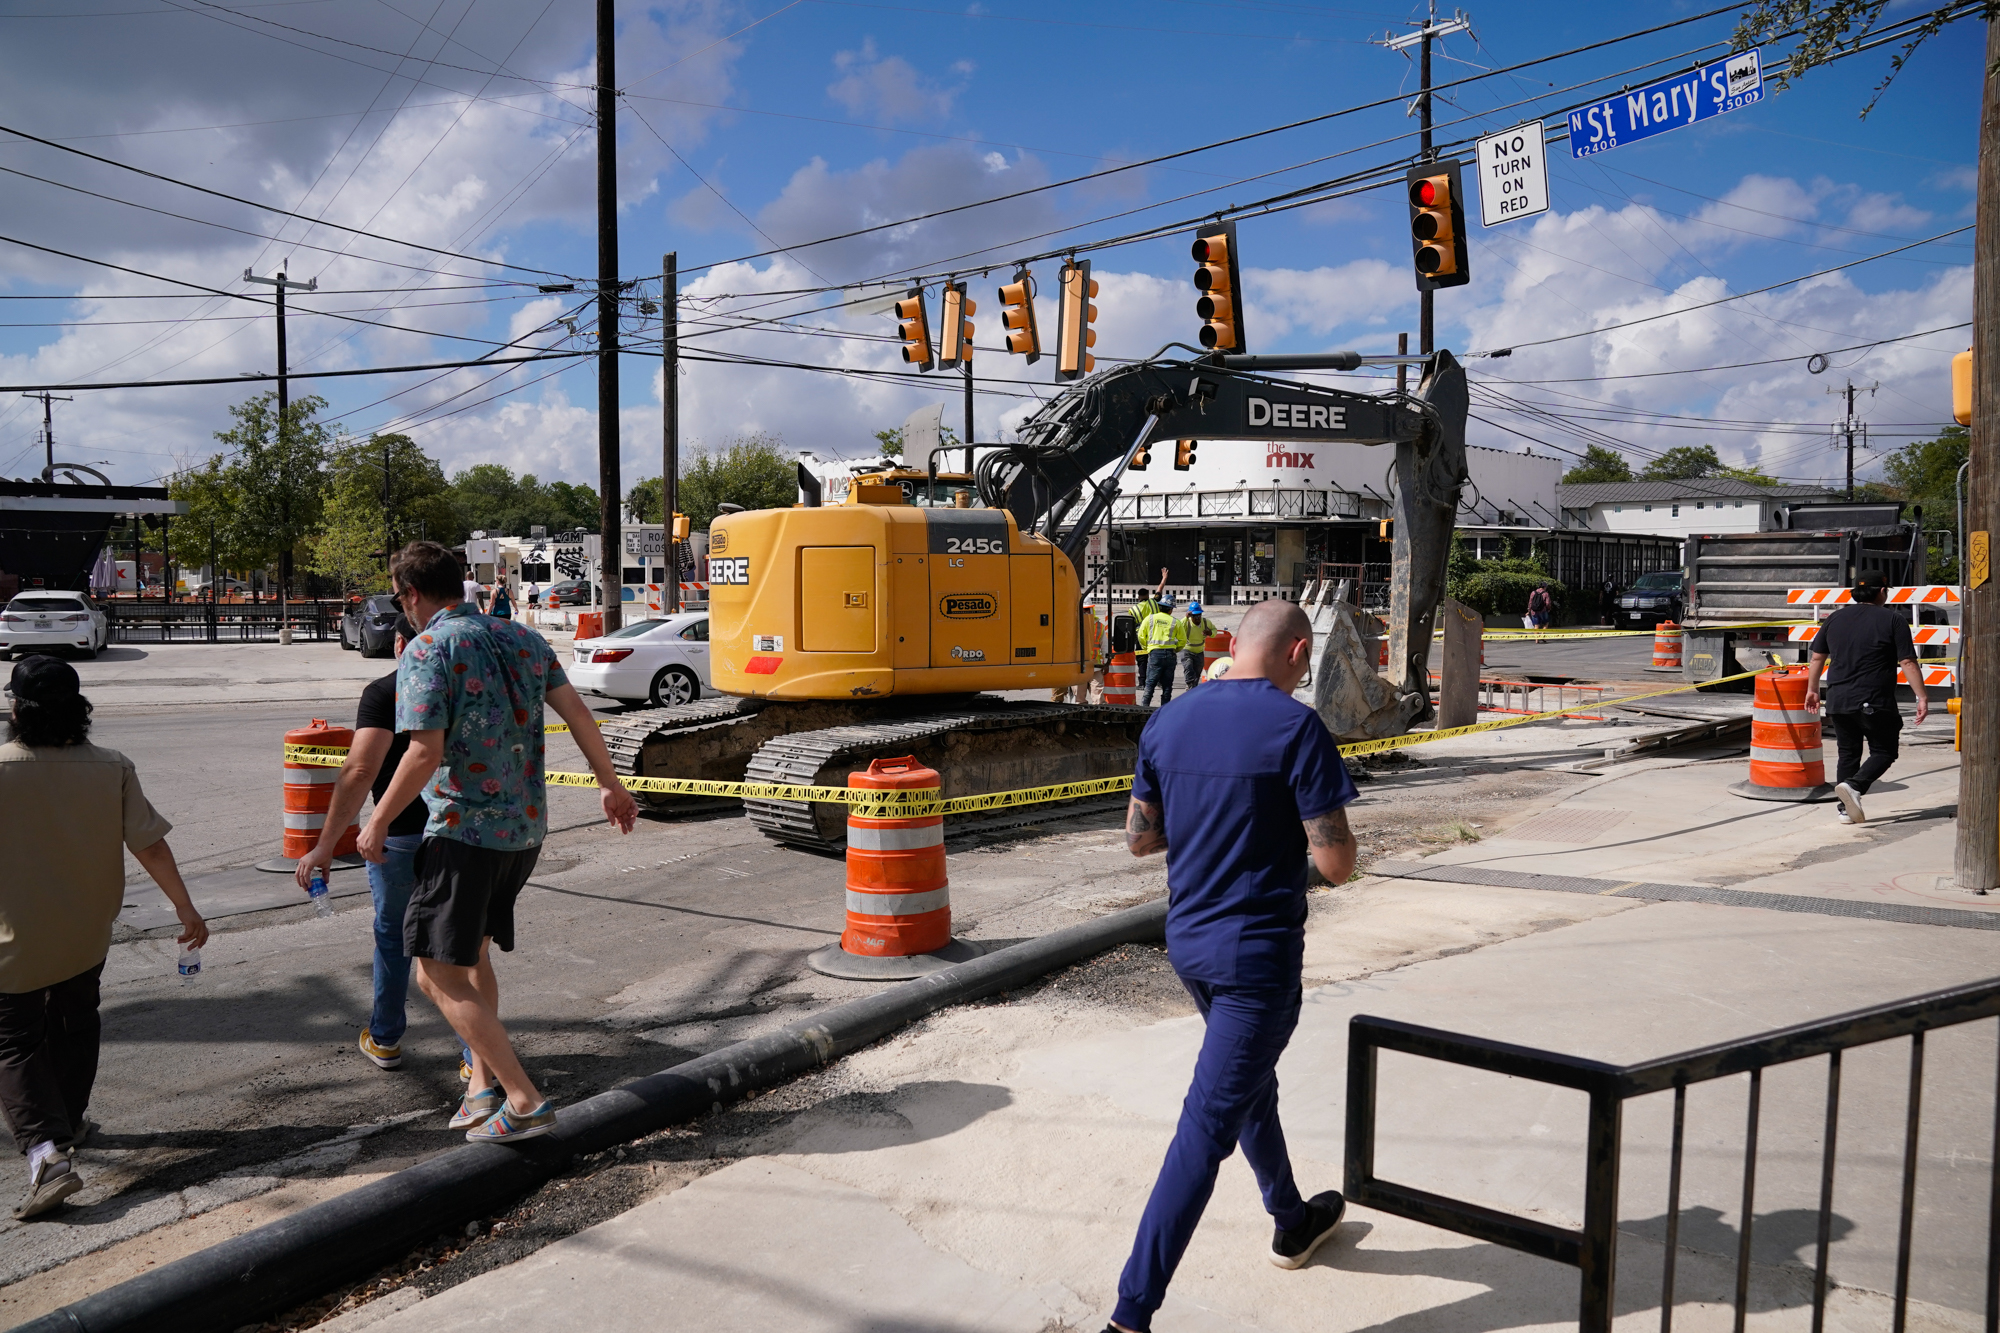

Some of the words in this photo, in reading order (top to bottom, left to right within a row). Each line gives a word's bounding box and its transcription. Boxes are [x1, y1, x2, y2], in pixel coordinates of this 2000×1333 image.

[1571, 112, 1582, 132] N
[1587, 102, 1617, 143] St
[1626, 68, 1726, 131] Mary's
[1716, 92, 1752, 114] 2500
[1494, 136, 1524, 159] NO
[1583, 137, 1617, 156] 2400
[1492, 155, 1531, 178] TURN
[1502, 176, 1524, 194] ON
[1500, 195, 1529, 215] RED
[1248, 397, 1346, 430] DEERE
[1267, 441, 1285, 453] the
[648, 532, 665, 542] ROA
[643, 544, 665, 553] CLOS
[946, 538, 1003, 554] 245G
[710, 558, 748, 583] EERE
[949, 558, 964, 568] LC
[946, 599, 991, 614] Pesado
[648, 780, 678, 791] CUIDADO
[693, 782, 725, 794] CAUTION
[741, 784, 774, 796] CUIDADO
[791, 787, 826, 799] CAUTION
[1068, 781, 1106, 796] CUIDADO
[845, 791, 883, 802] CUIDADO
[950, 797, 991, 811] CUIDADO
[1012, 789, 1050, 804] CAUTION
[886, 805, 930, 817] CAUTION
